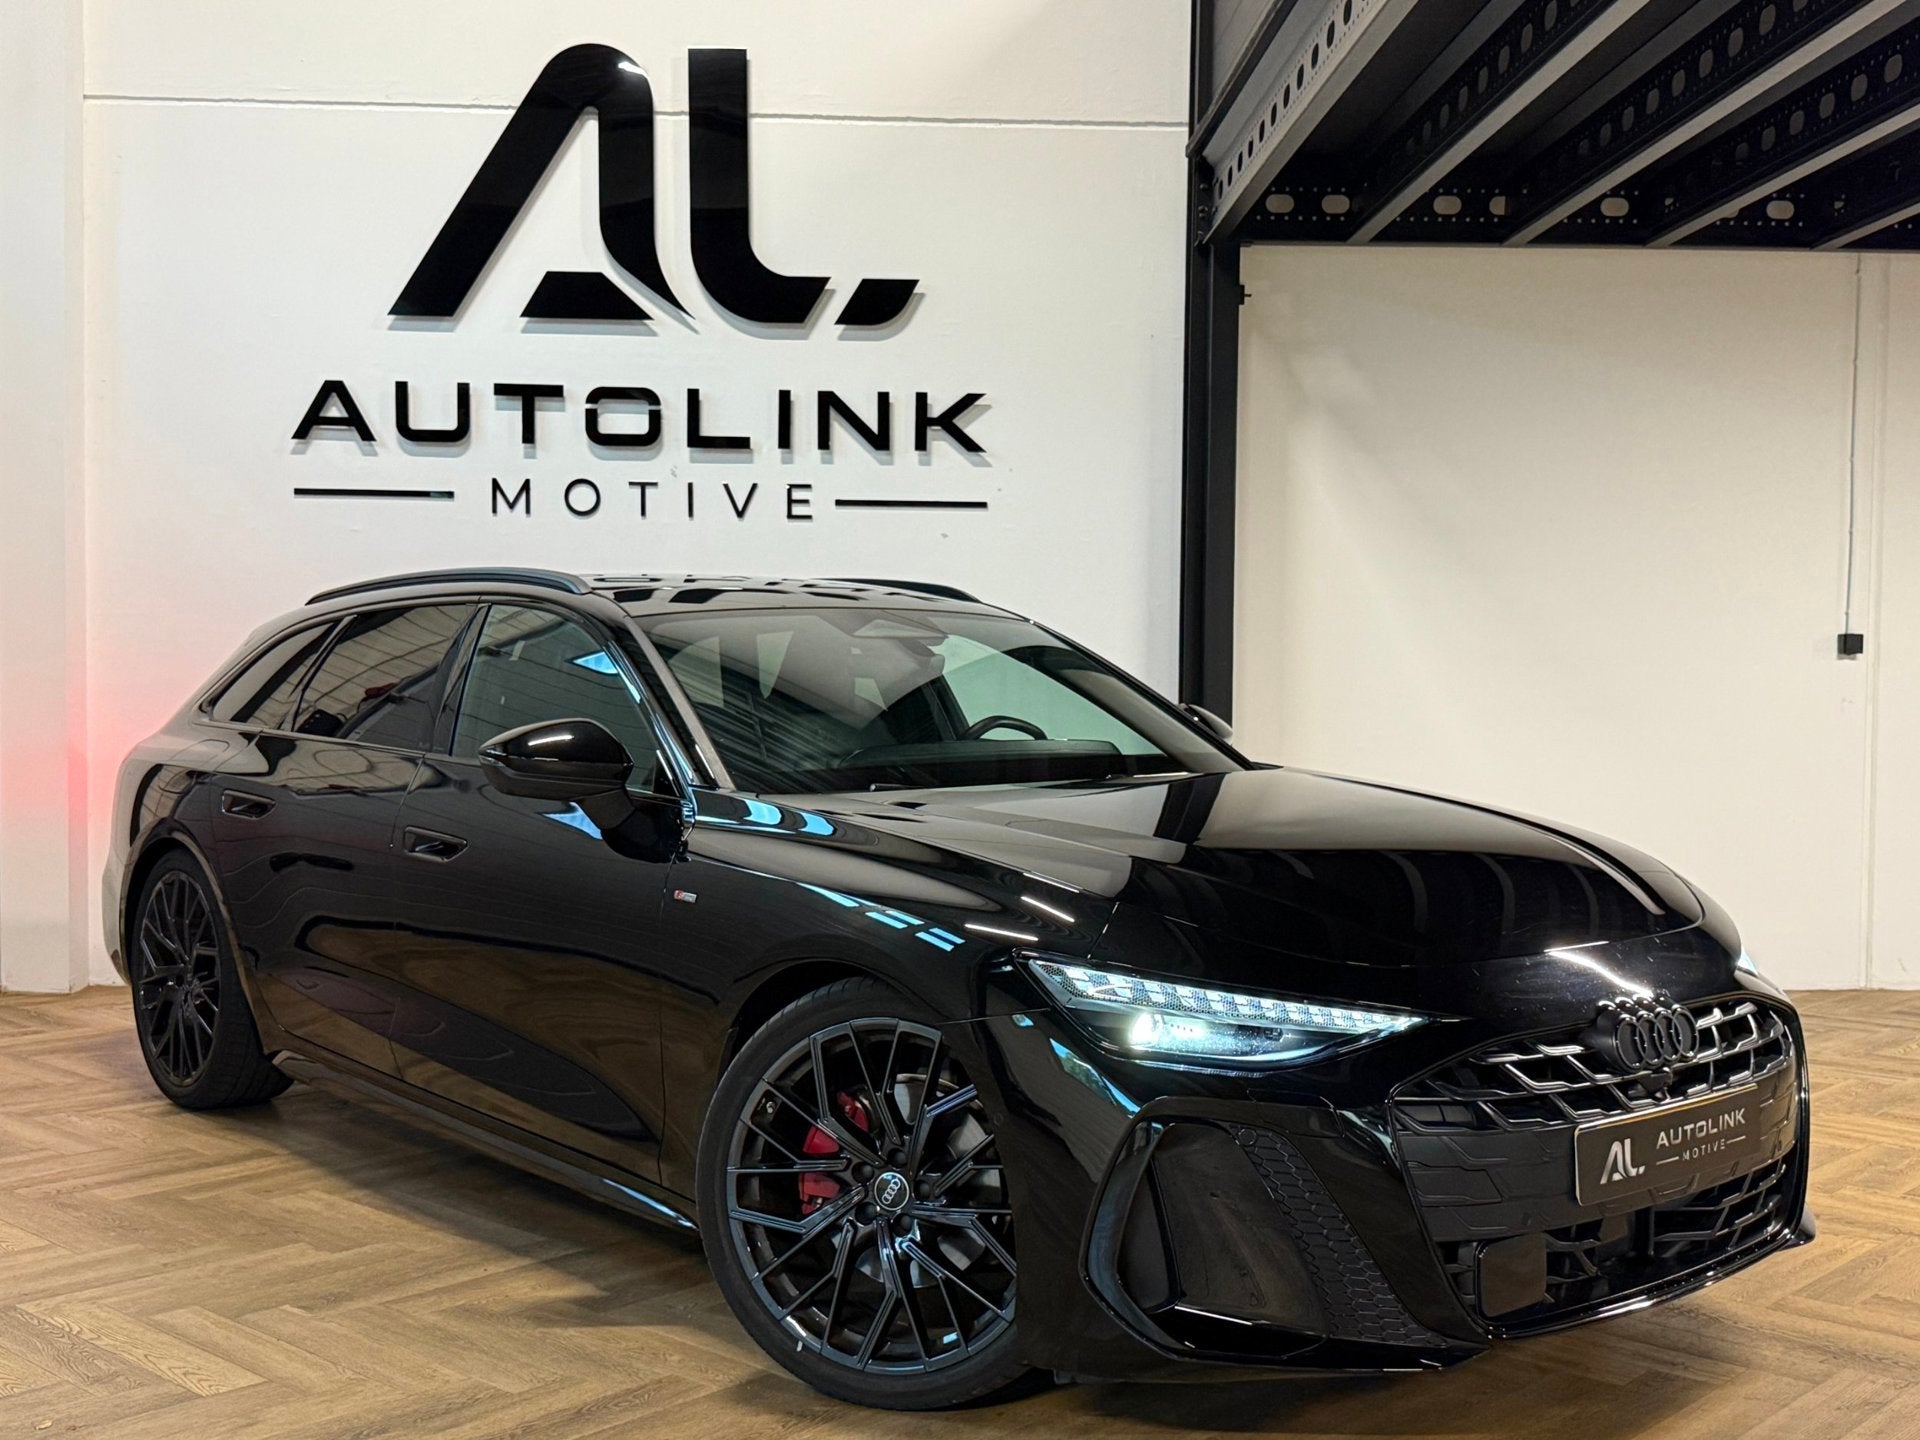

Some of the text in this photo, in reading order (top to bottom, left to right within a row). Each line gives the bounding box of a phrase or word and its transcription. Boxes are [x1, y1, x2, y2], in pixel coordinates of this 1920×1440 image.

[291, 380, 987, 453] AUTOLINK
[491, 477, 813, 520] MOTIVE
[1656, 1109, 1746, 1149] AUTOLINK
[1682, 1139, 1726, 1161] MOTIVE
